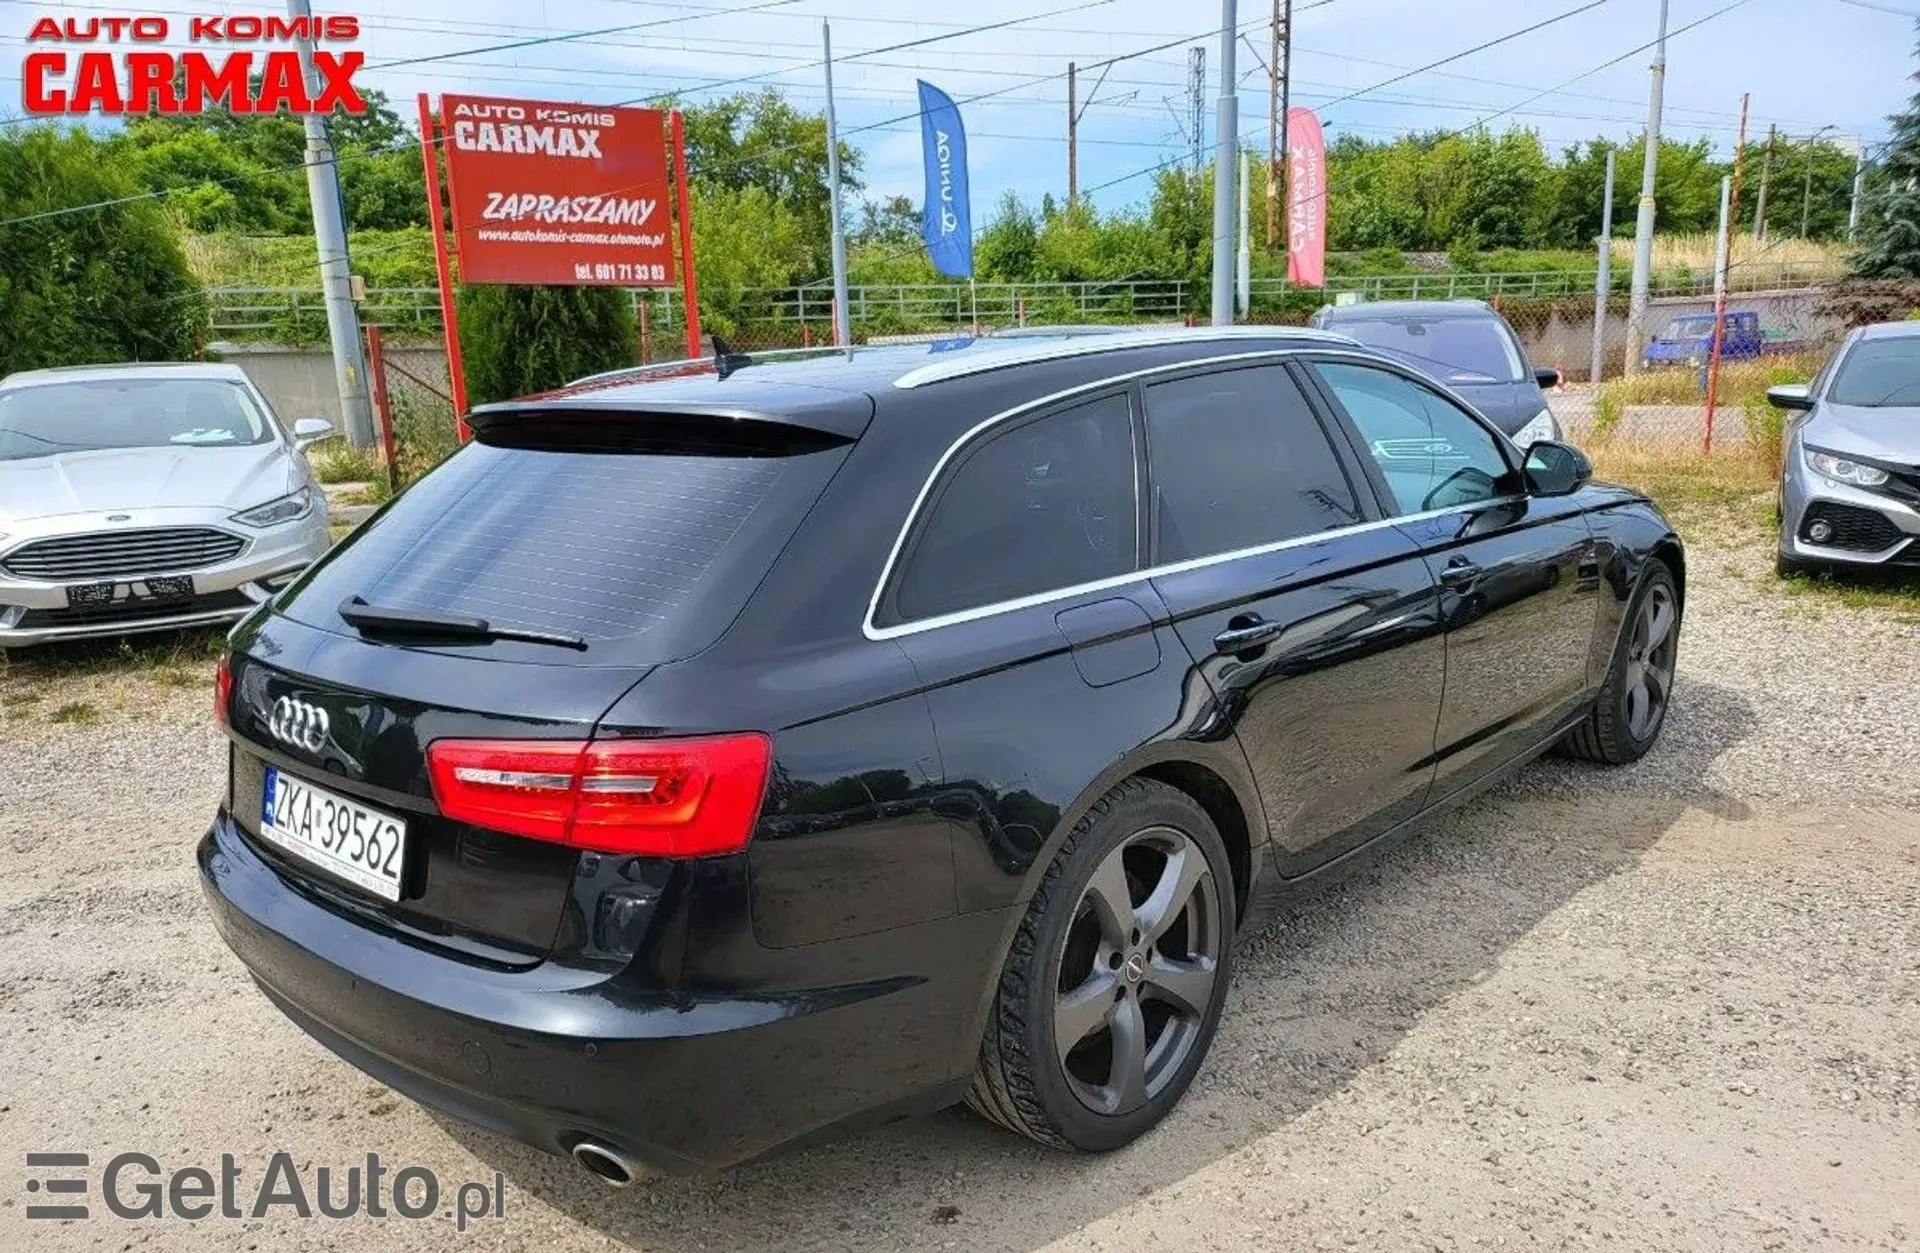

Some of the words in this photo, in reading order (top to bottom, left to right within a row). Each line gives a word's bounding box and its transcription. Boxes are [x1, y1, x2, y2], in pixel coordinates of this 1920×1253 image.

[454, 103, 526, 121] AUTO
[536, 109, 616, 127] KOMIS
[454, 121, 603, 159] CARMAX
[482, 192, 657, 226] ZAPRASZAMY
[574, 263, 594, 281] tel.
[618, 264, 632, 281] 71
[275, 777, 312, 842] ZKA
[321, 799, 401, 880] 39562
